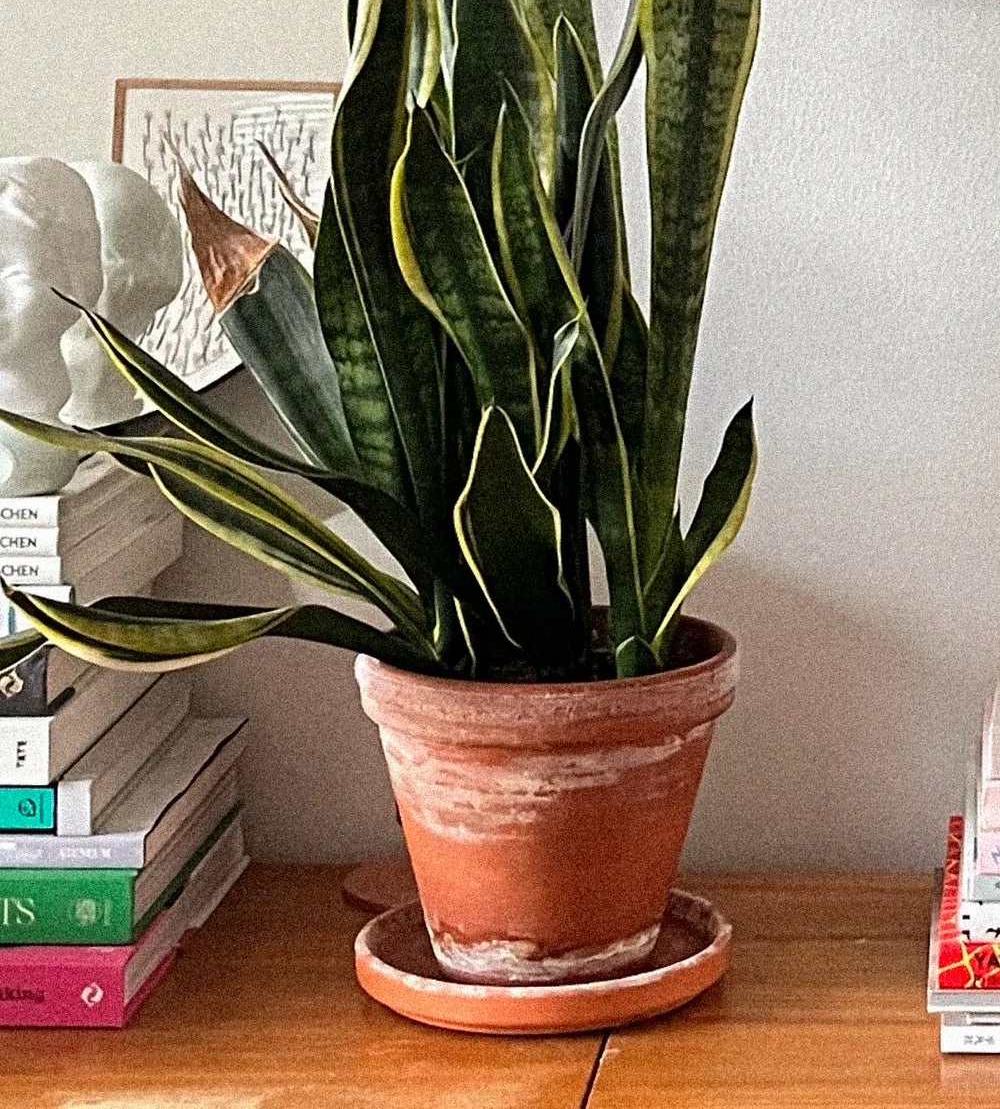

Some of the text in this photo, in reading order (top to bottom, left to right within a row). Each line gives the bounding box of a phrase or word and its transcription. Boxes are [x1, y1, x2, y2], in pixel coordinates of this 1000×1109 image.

[0, 508, 38, 520] CHEN
[0, 536, 37, 548] CHEN
[1, 565, 39, 577] CHEN
